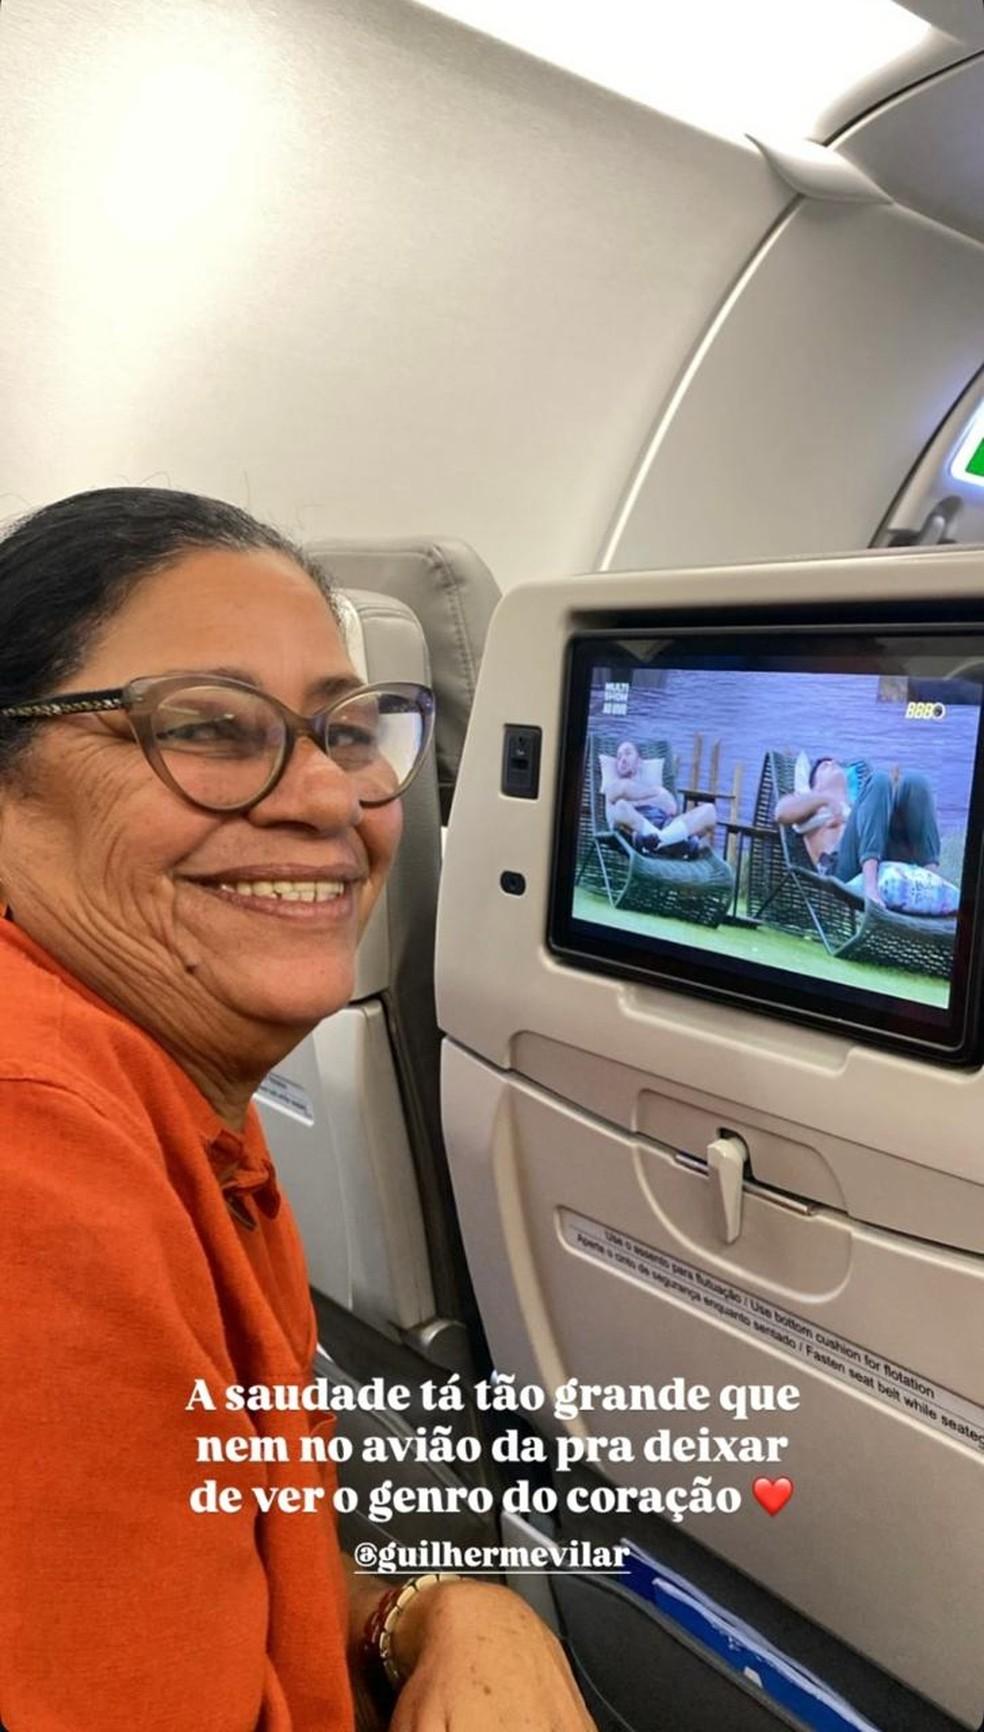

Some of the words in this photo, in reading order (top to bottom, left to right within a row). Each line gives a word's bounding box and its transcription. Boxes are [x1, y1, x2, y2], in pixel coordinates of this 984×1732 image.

[577, 1233, 605, 1254] Aperte
[638, 1263, 650, 1276] de
[753, 1321, 796, 1349] sentado
[806, 1344, 845, 1373] Fasten
[848, 1368, 874, 1388] seat
[877, 1381, 900, 1402] belt
[903, 1395, 937, 1420] while
[604, 1230, 623, 1246] Use
[625, 1241, 632, 1250] o
[633, 1245, 669, 1269] assento
[671, 1264, 694, 1281] para
[750, 1300, 772, 1319] Use
[774, 1311, 813, 1339] bottom
[815, 1333, 862, 1363] cushion
[864, 1355, 881, 1372] for
[883, 1364, 936, 1399] flotation
